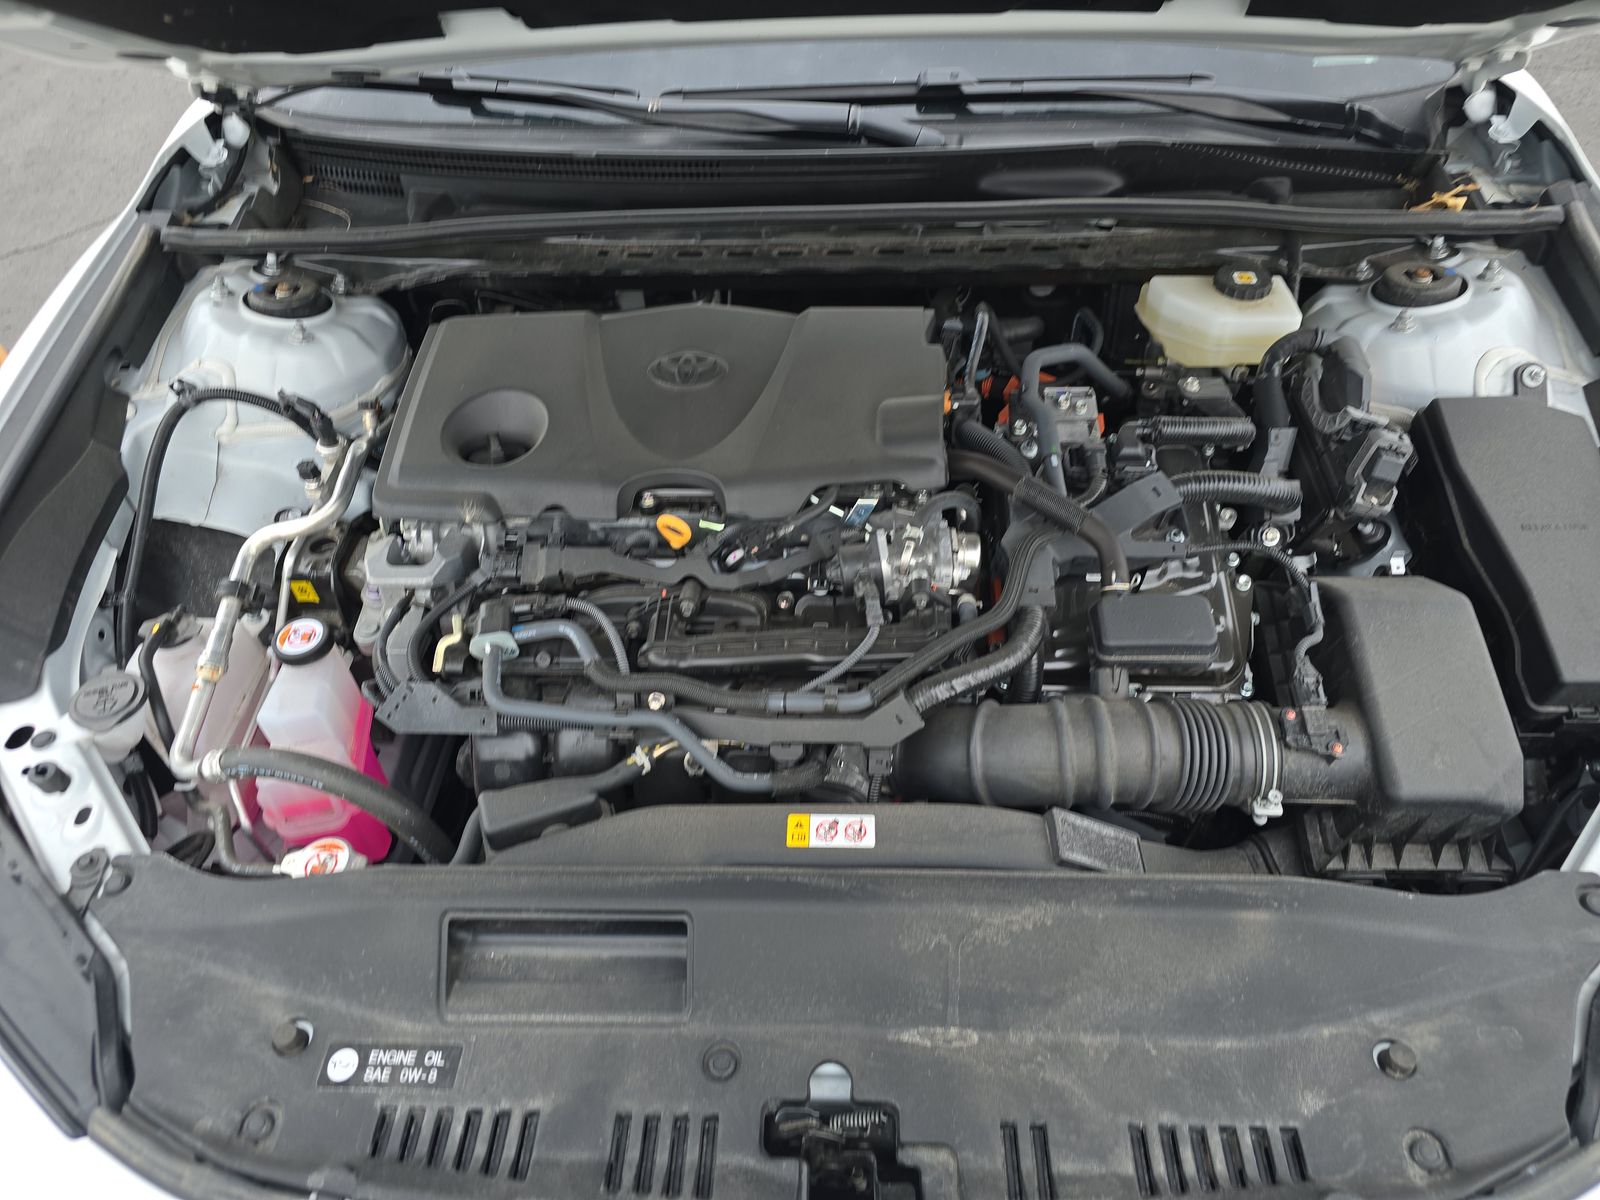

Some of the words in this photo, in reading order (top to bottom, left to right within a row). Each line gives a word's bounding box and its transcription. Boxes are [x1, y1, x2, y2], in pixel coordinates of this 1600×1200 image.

[368, 1049, 417, 1066] ENGINE
[424, 1050, 445, 1067] OIL
[364, 1066, 391, 1083] SAE
